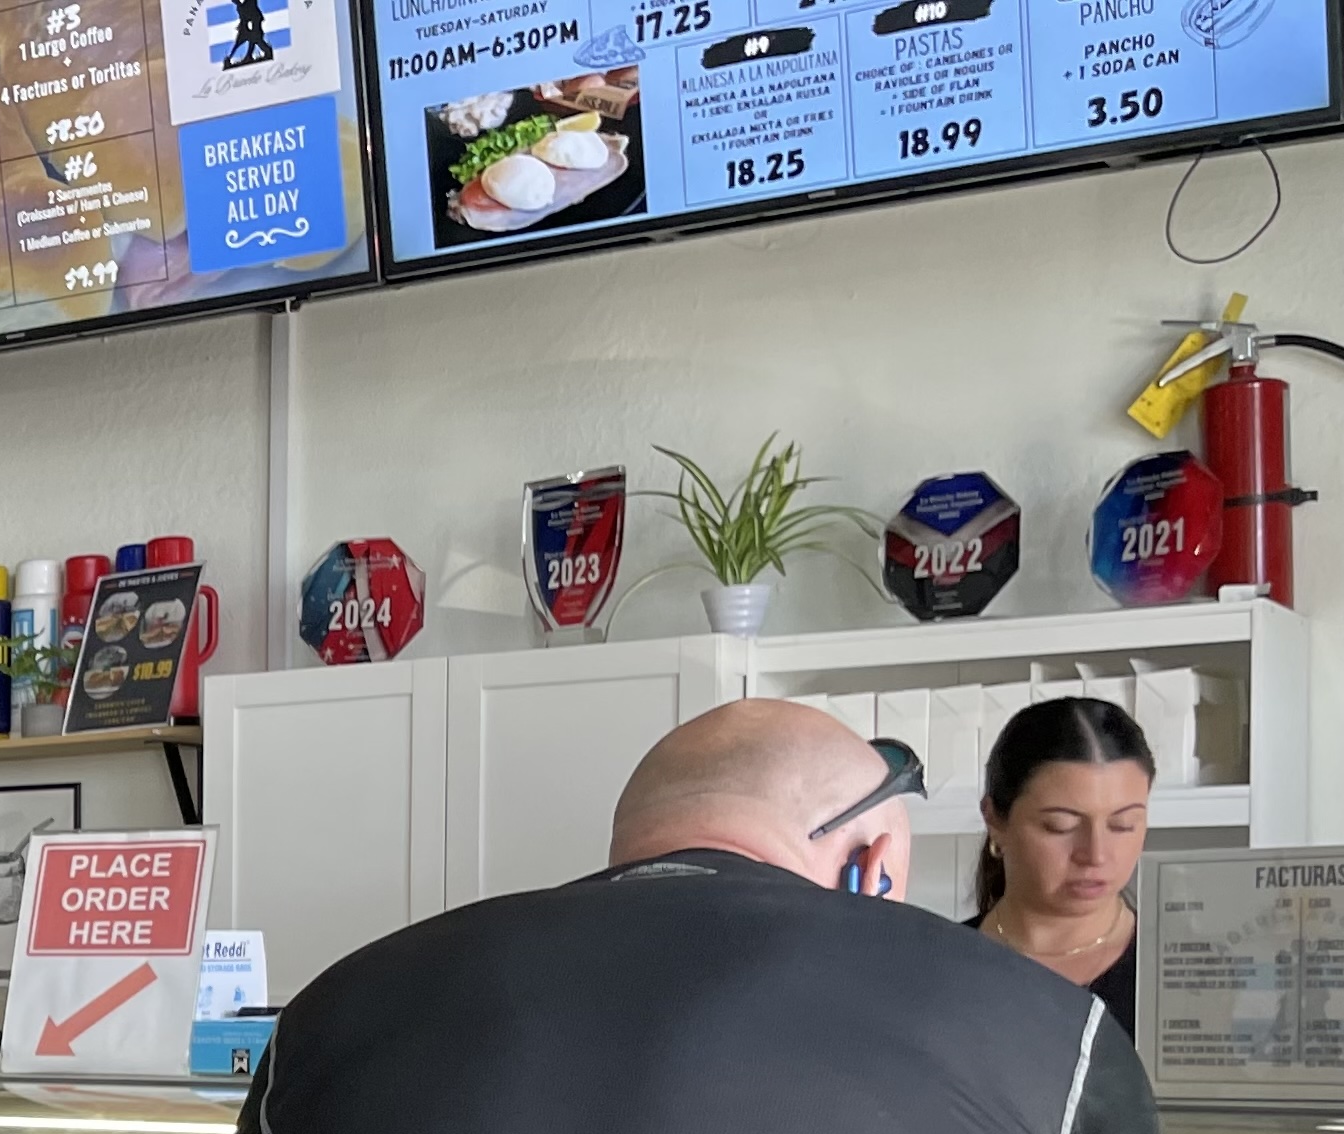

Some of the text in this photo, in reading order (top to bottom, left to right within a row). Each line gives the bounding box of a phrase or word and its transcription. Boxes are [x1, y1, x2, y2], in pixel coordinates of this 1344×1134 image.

[47, 3, 81, 36] #3
[634, 1, 711, 43] 17.25
[914, 1, 947, 23] #10
[19, 26, 113, 61] 1 Large Coffee
[895, 27, 963, 61] PASTAS
[1084, 33, 1155, 59] PANCHO
[749, 62, 763, 81] LA
[766, 50, 839, 77] NAPOLITANA
[855, 64, 896, 81] CHOICE
[1092, 57, 1136, 78] SODA
[1143, 49, 1180, 68] CAN
[1, 61, 141, 105] 4 Facturas or Tortitas
[751, 86, 765, 97] LA
[874, 73, 930, 92] RAVIOLES
[1087, 87, 1163, 128] 3.50
[204, 125, 306, 168] BREAKFAST
[899, 117, 982, 160] 18.99
[64, 151, 98, 181] #6
[225, 159, 296, 193] SERVED
[726, 149, 804, 189] 18.25
[227, 188, 300, 224] ALL DAY
[1121, 516, 1185, 562] 2021
[548, 553, 600, 590] 2023
[914, 538, 983, 579] 2022
[328, 597, 391, 631] 2024
[69, 853, 172, 878] PLACE
[61, 886, 170, 912] ORDER
[68, 920, 153, 945] HERE
[214, 942, 246, 958] Reddi
